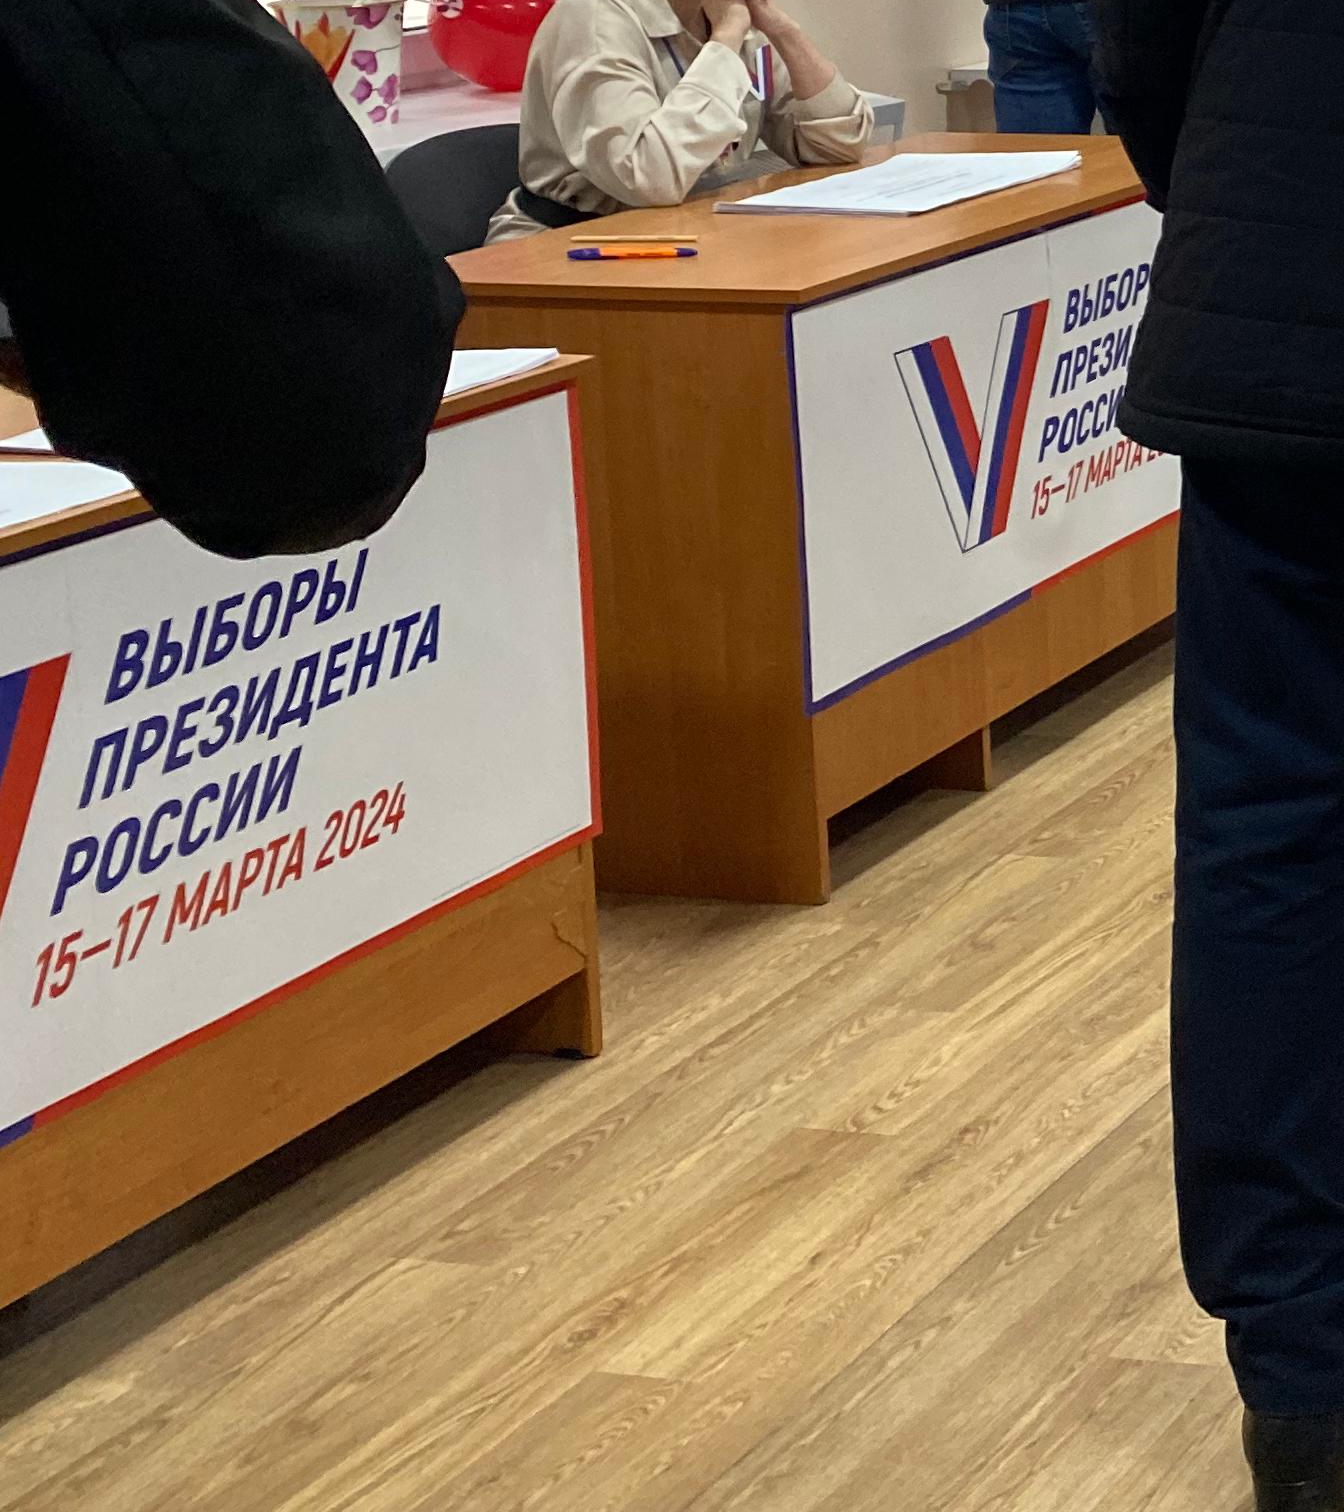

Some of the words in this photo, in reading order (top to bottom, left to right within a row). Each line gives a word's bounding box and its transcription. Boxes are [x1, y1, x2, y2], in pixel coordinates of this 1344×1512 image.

[1063, 263, 1151, 334] ВЫБОР
[1049, 324, 1133, 399] ПРЕЗИ
[1038, 384, 1125, 463] РОССИ
[1084, 437, 1143, 493] МАРТА
[104, 549, 369, 705] ВЫБОРЫ
[78, 604, 442, 809] ПРЕЗИДЕНТА
[51, 747, 303, 917] РОССИИ
[163, 828, 306, 944] МАРТА
[313, 781, 406, 872] 2024
